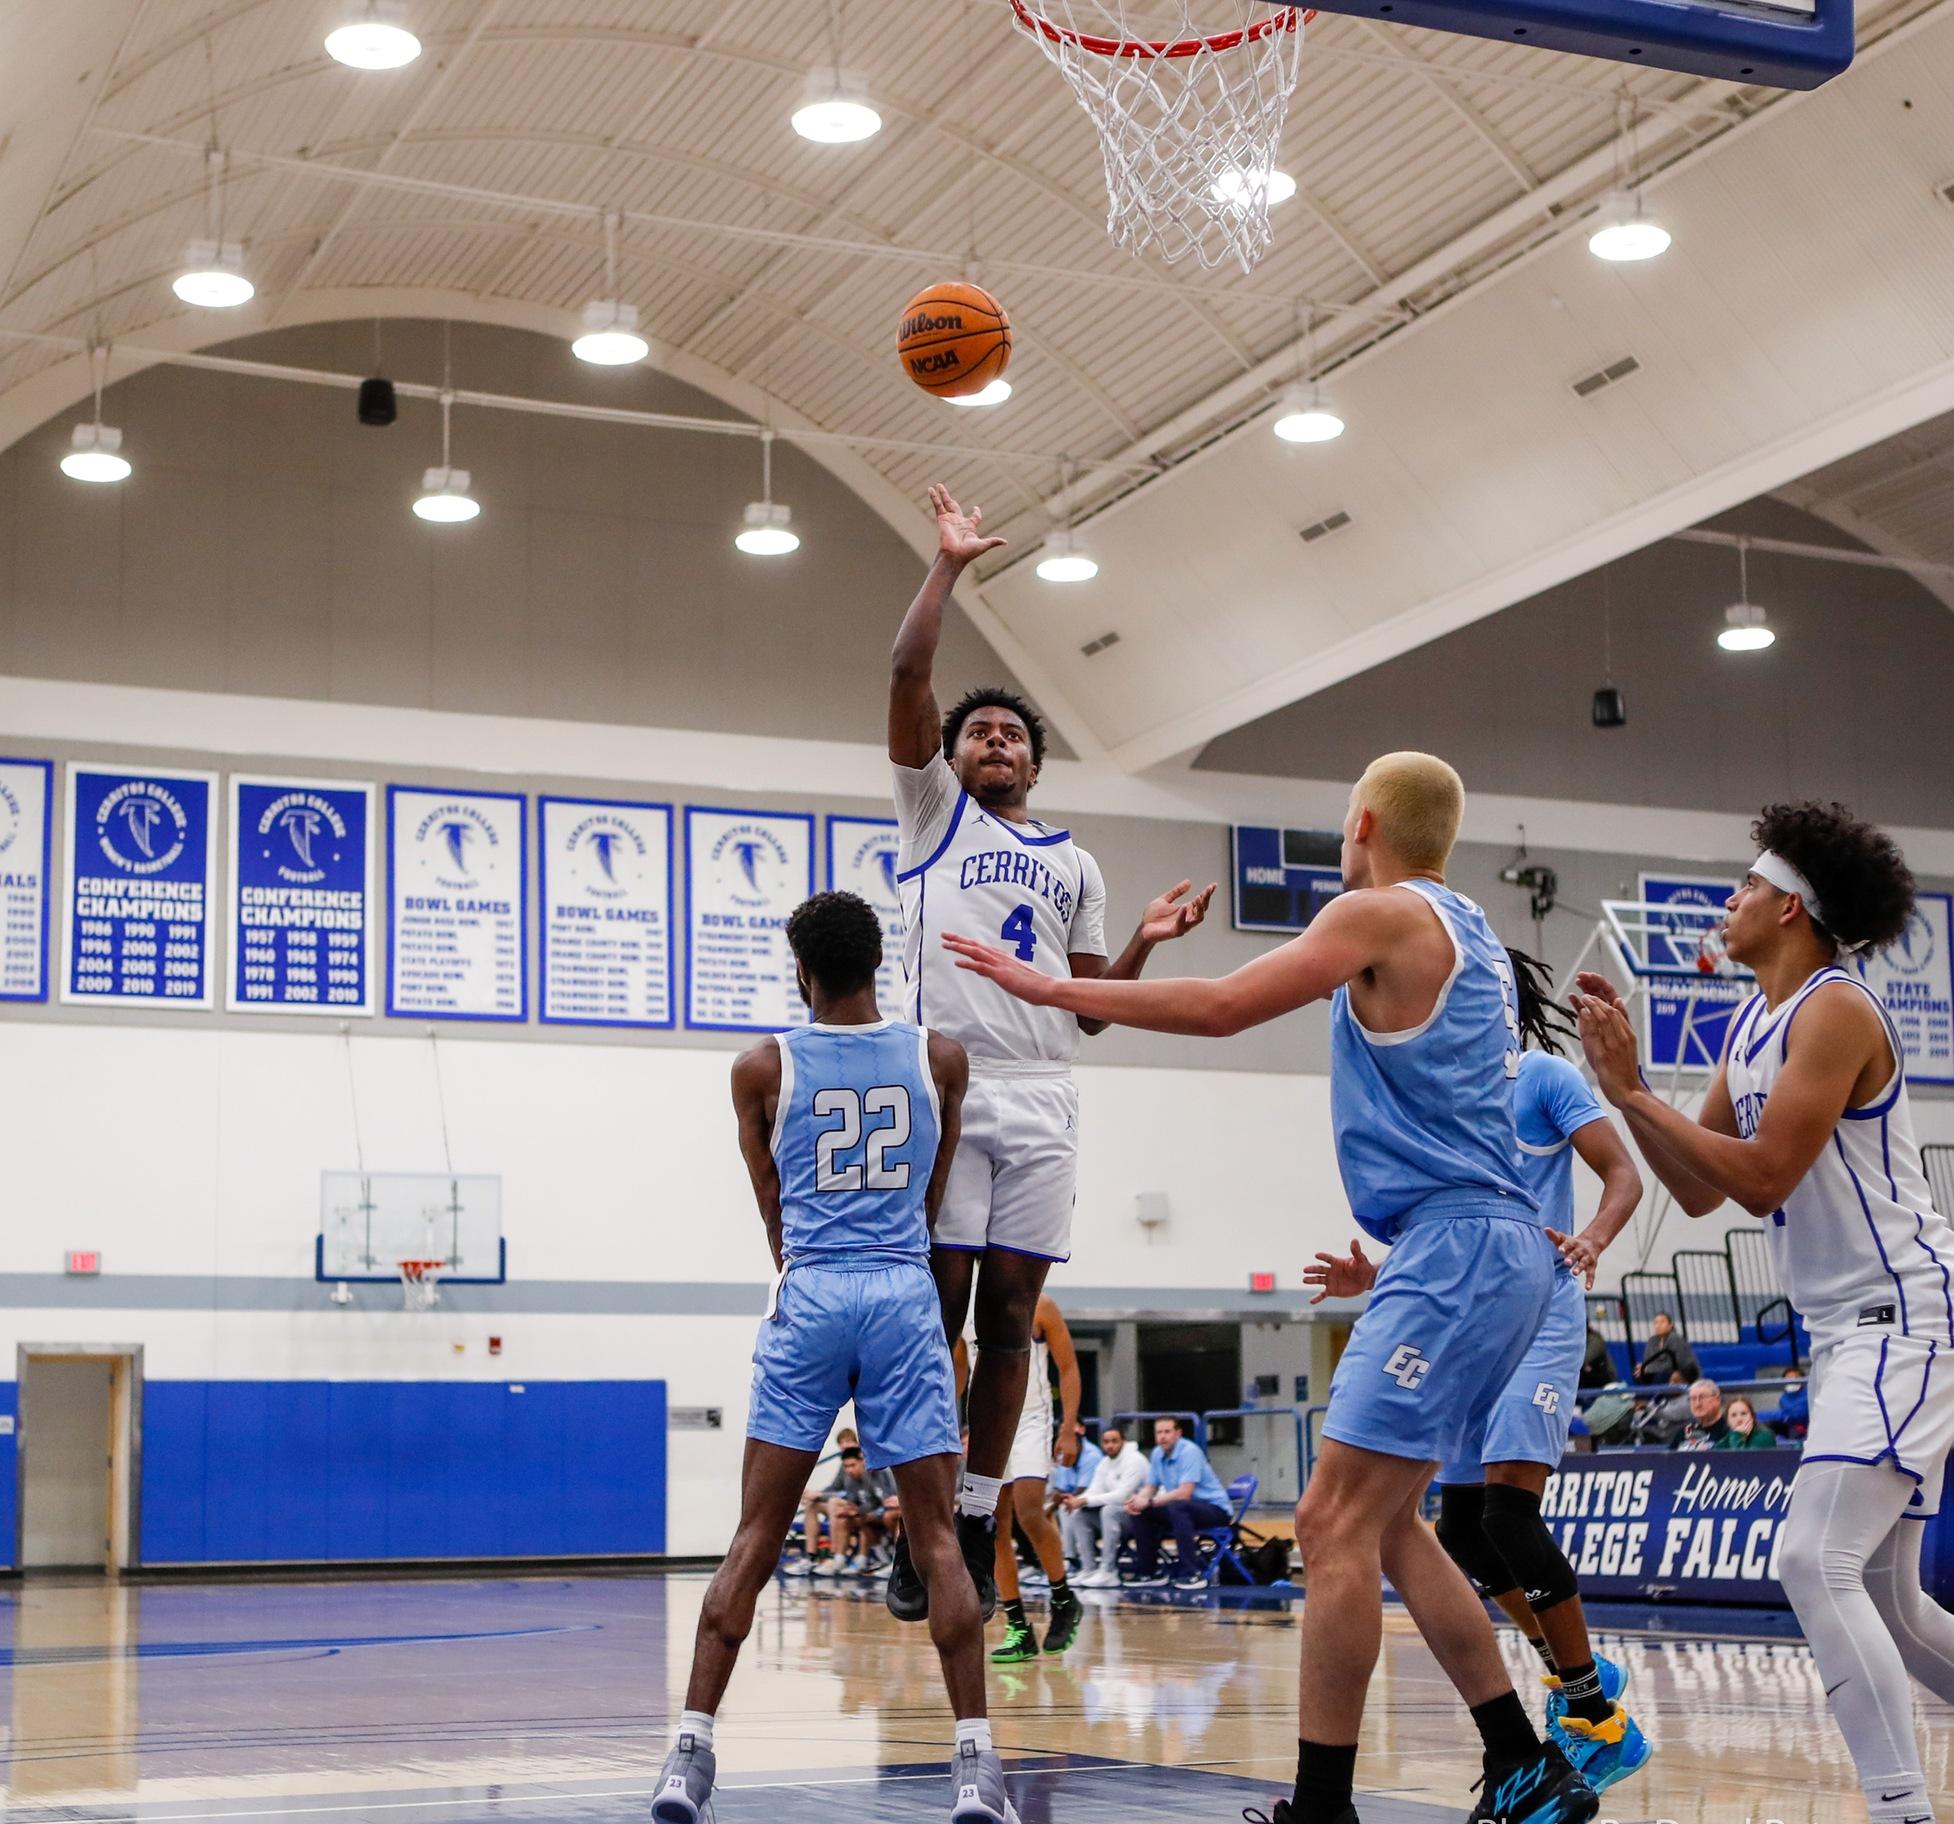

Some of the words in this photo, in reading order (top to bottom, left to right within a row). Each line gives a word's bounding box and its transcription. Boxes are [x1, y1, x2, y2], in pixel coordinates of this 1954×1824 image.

[900, 312, 962, 342] Wilson
[910, 350, 961, 373] NCAA
[0, 874, 37, 888] ALS
[960, 850, 1072, 924] CERRITOS
[1245, 866, 1287, 886] HOME
[77, 876, 203, 900] CONFERENCE
[241, 886, 362, 909] CONFERENCE
[77, 896, 203, 922] CHAMPIONS
[241, 906, 362, 930] CHAMPIONS
[405, 897, 451, 912] BOWL
[456, 899, 511, 916] GAMES
[557, 906, 601, 921] BOWL
[605, 908, 659, 924] GAMES
[702, 912, 745, 928] BOWL
[748, 915, 789, 930] GAM
[1001, 903, 1038, 962] 4
[122, 977, 154, 994] 2010
[1886, 982, 1930, 996] STATE
[1884, 998, 1950, 1013] AMPIONS
[813, 1084, 912, 1193] 22
[1882, 1310, 1889, 1318] L
[1381, 1342, 1431, 1391] EC
[1531, 1381, 1560, 1416] EC
[1539, 1470, 1654, 1518] RRITOS
[1671, 1462, 1768, 1514] Home
[1545, 1521, 1650, 1577] LEGE
[669, 1779, 682, 1789] 23
[962, 1788, 975, 1799] 23
